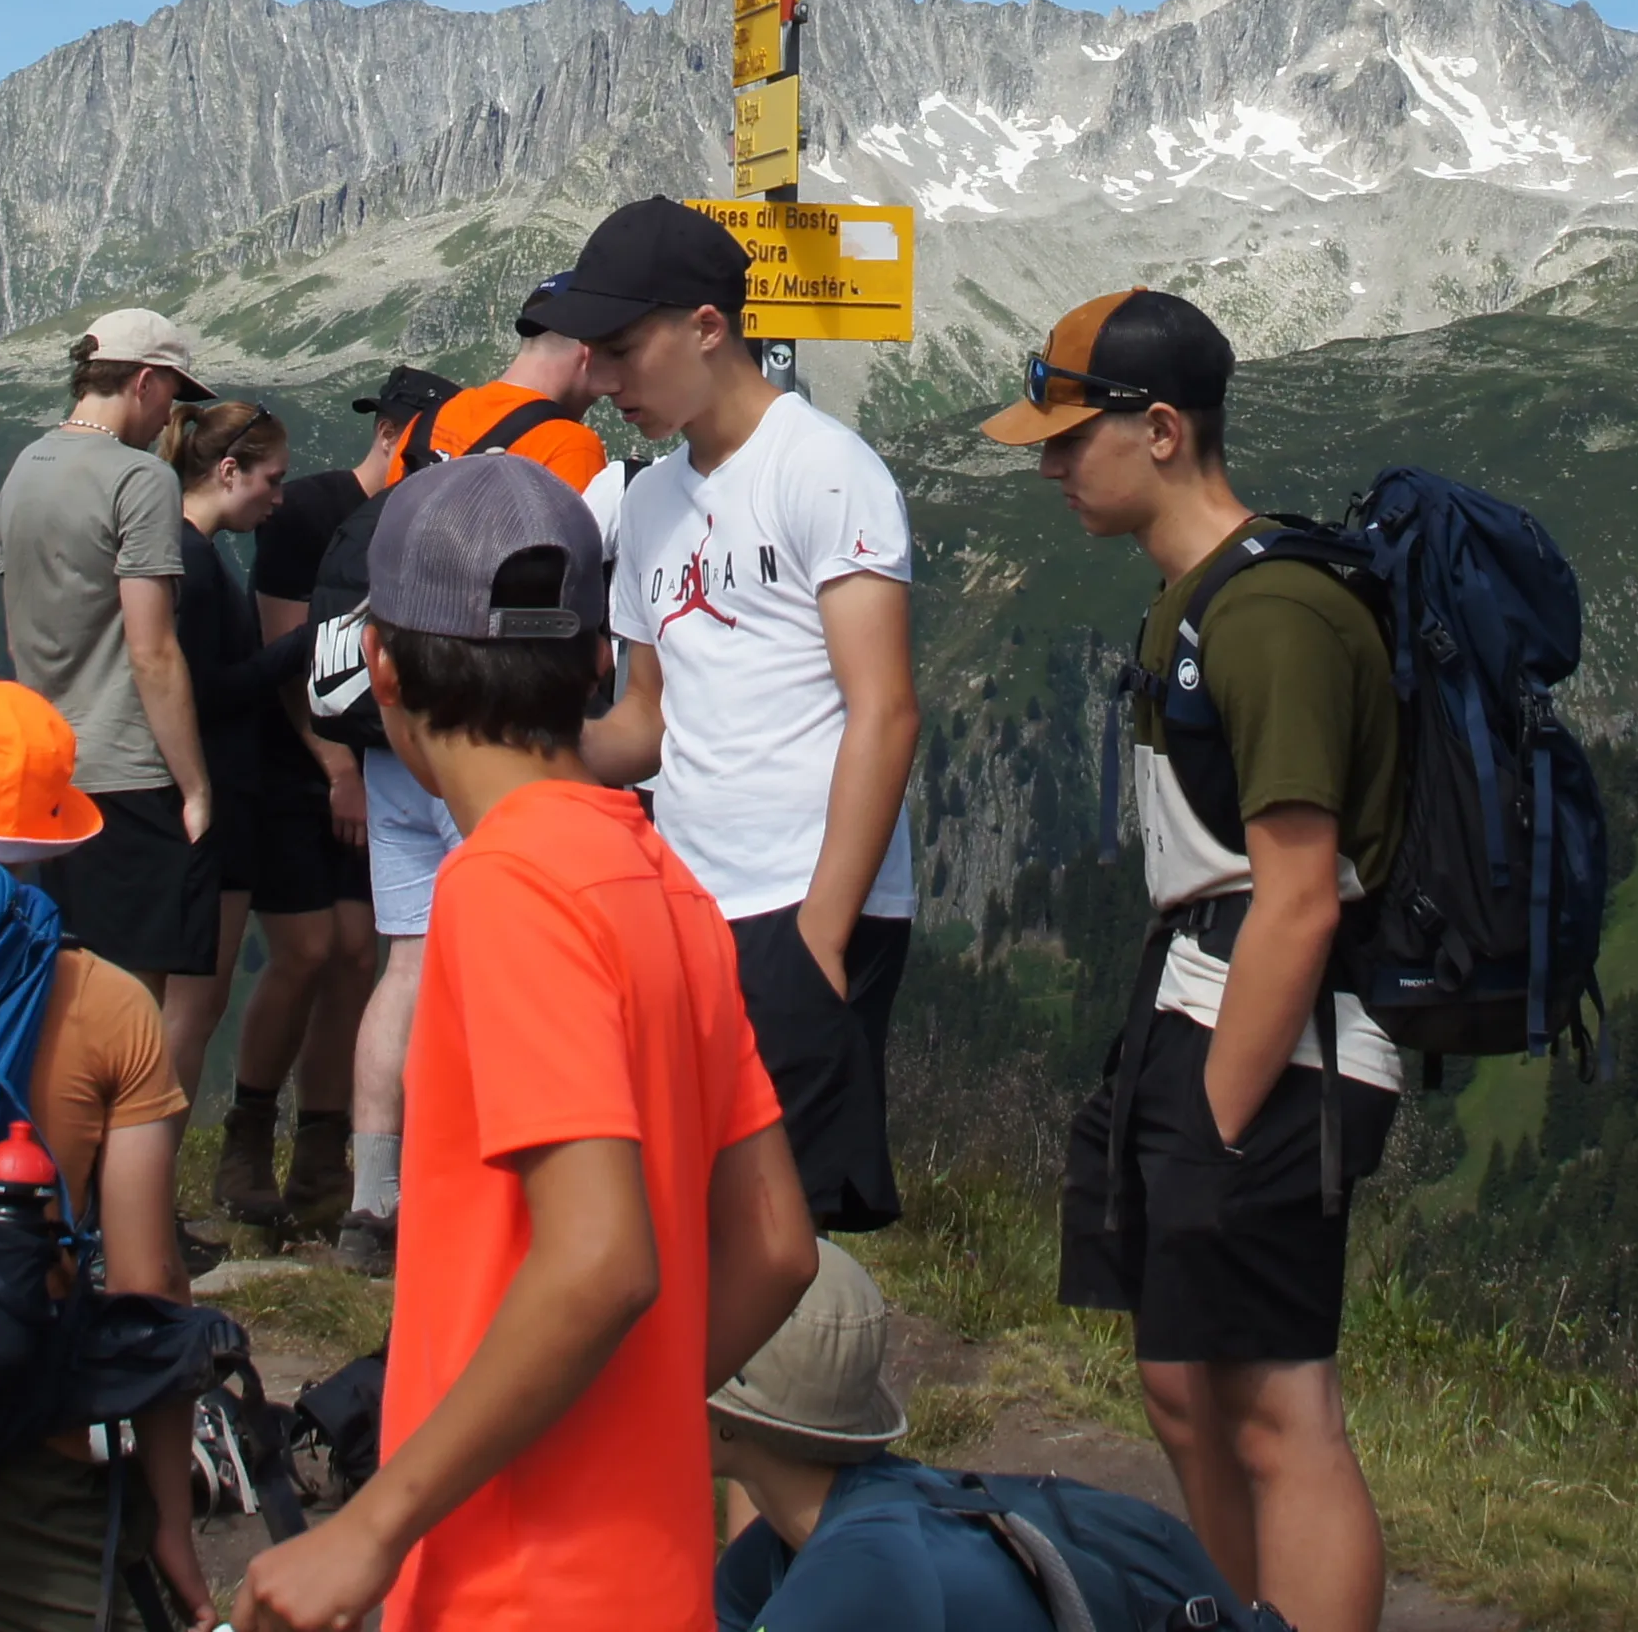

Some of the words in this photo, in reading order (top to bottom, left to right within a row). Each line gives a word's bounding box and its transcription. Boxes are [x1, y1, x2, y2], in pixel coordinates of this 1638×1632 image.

[756, 206, 777, 229] dil
[785, 206, 838, 235] Bostg
[746, 239, 788, 263] Sura
[746, 272, 846, 299] tis/Mustér
